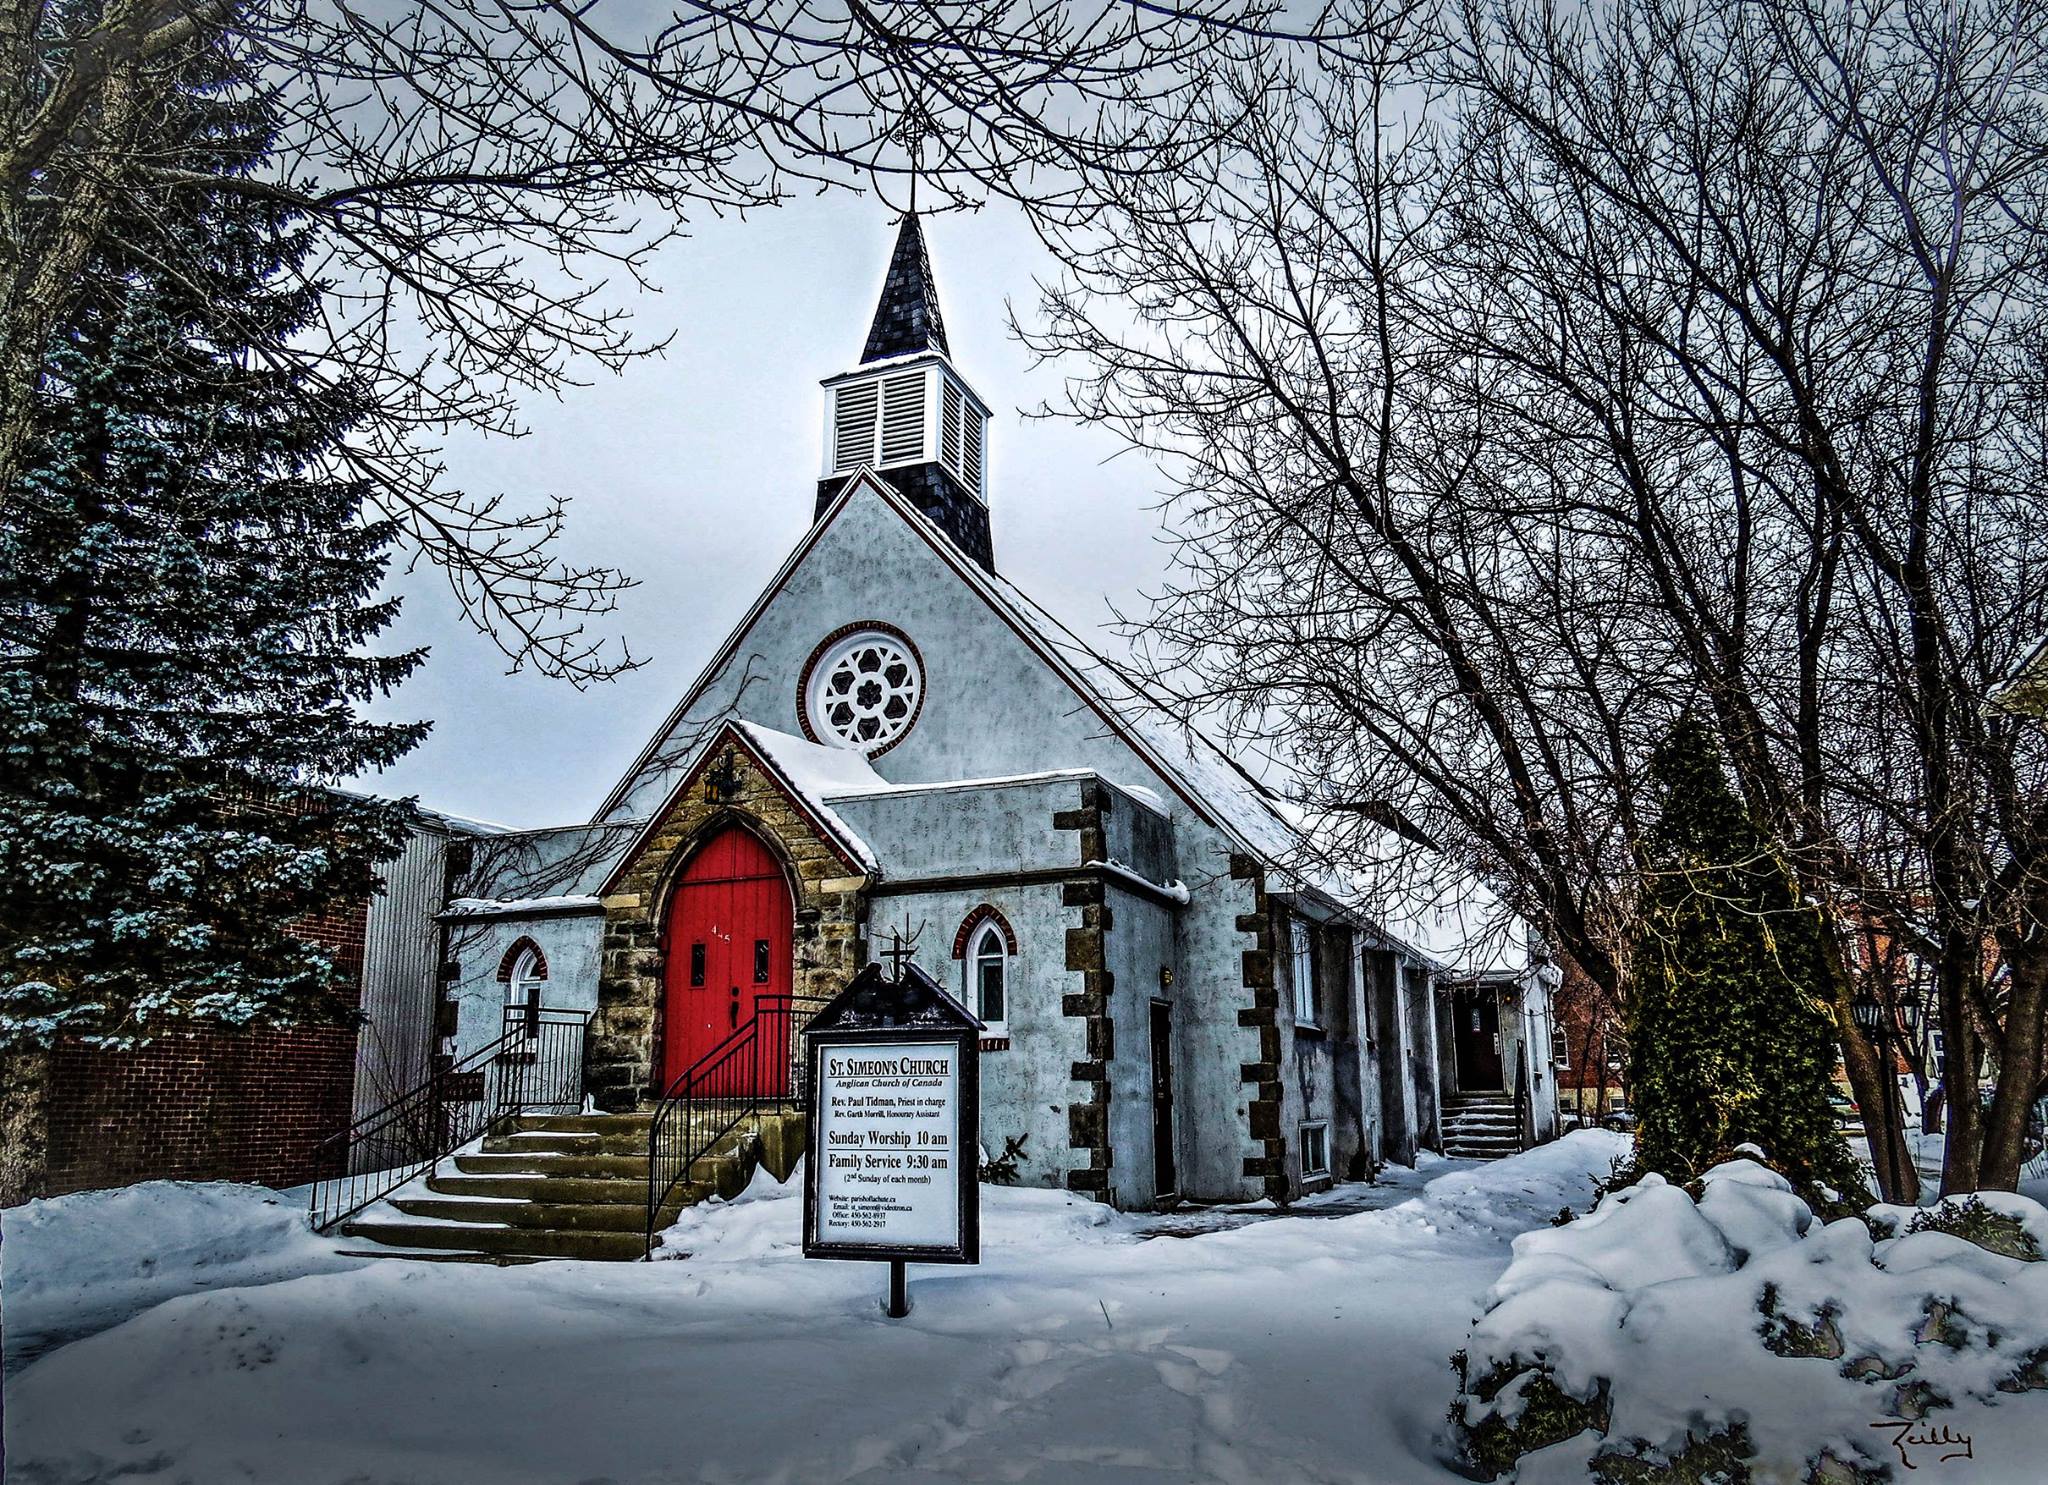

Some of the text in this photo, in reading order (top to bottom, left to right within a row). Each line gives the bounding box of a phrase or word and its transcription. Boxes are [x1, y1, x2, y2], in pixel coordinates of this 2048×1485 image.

[830, 1057, 949, 1075] ST. SIMEON'S CHURCH
[836, 1078, 943, 1089] Anglican Church of Canada
[832, 1096, 946, 1110] Rev. Paul Tidman, Priest in charge
[834, 1110, 846, 1118] Rev.
[847, 1110, 863, 1118] Garth
[915, 1110, 940, 1118] Assistant
[829, 1131, 948, 1148] Sunday Worship 10 am
[829, 1154, 948, 1171] Family Service 9:30 am
[858, 1174, 881, 1184] Sunday
[882, 1174, 891, 1183] of
[891, 1175, 906, 1183] each
[907, 1175, 931, 1184] month)
[832, 1211, 849, 1219] Office:
[828, 1220, 849, 1228] Rectory:
